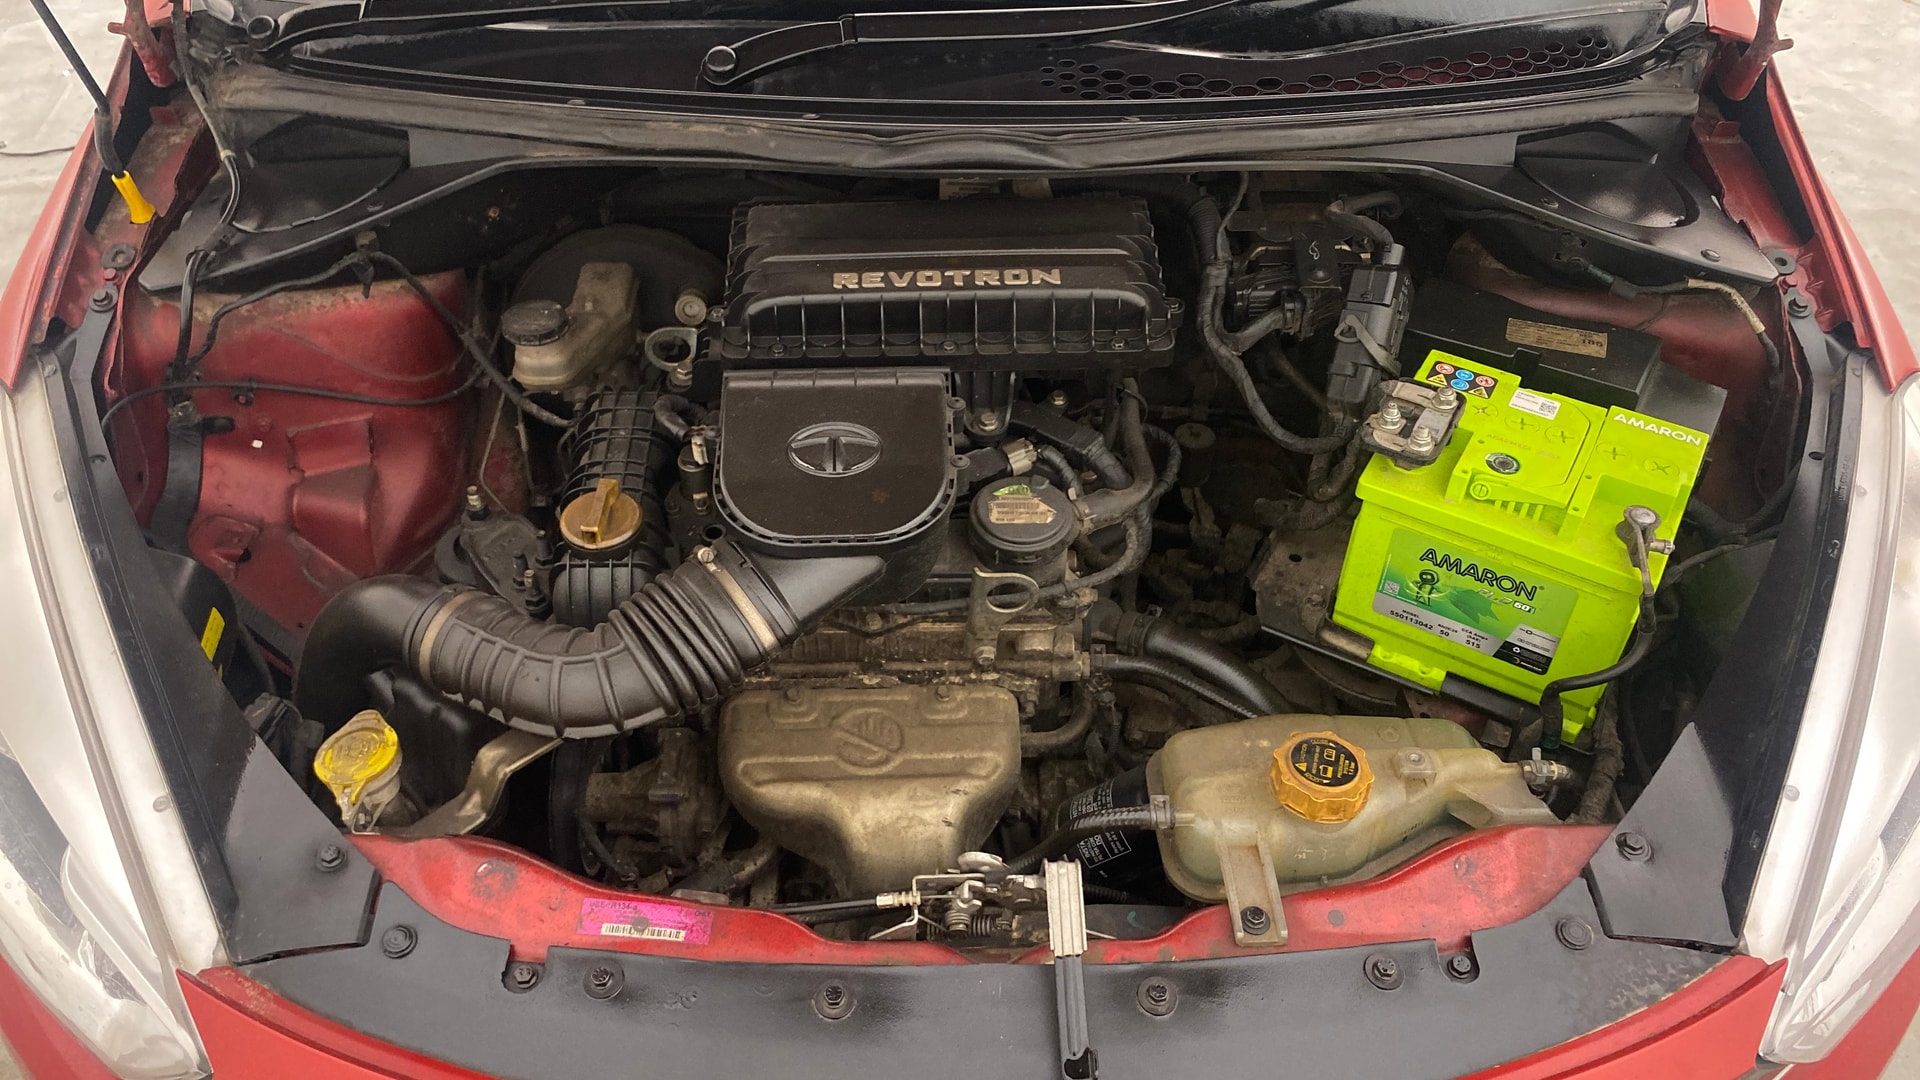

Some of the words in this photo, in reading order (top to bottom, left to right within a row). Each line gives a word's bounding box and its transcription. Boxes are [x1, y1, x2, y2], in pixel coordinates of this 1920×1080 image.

[832, 268, 1061, 289] REVOTRON
[1614, 413, 1702, 446] AMARON
[1420, 548, 1538, 601] AMARON
[1390, 610, 1434, 630] 550113042
[1402, 610, 1419, 618] MODEL
[1466, 640, 1480, 648] 515
